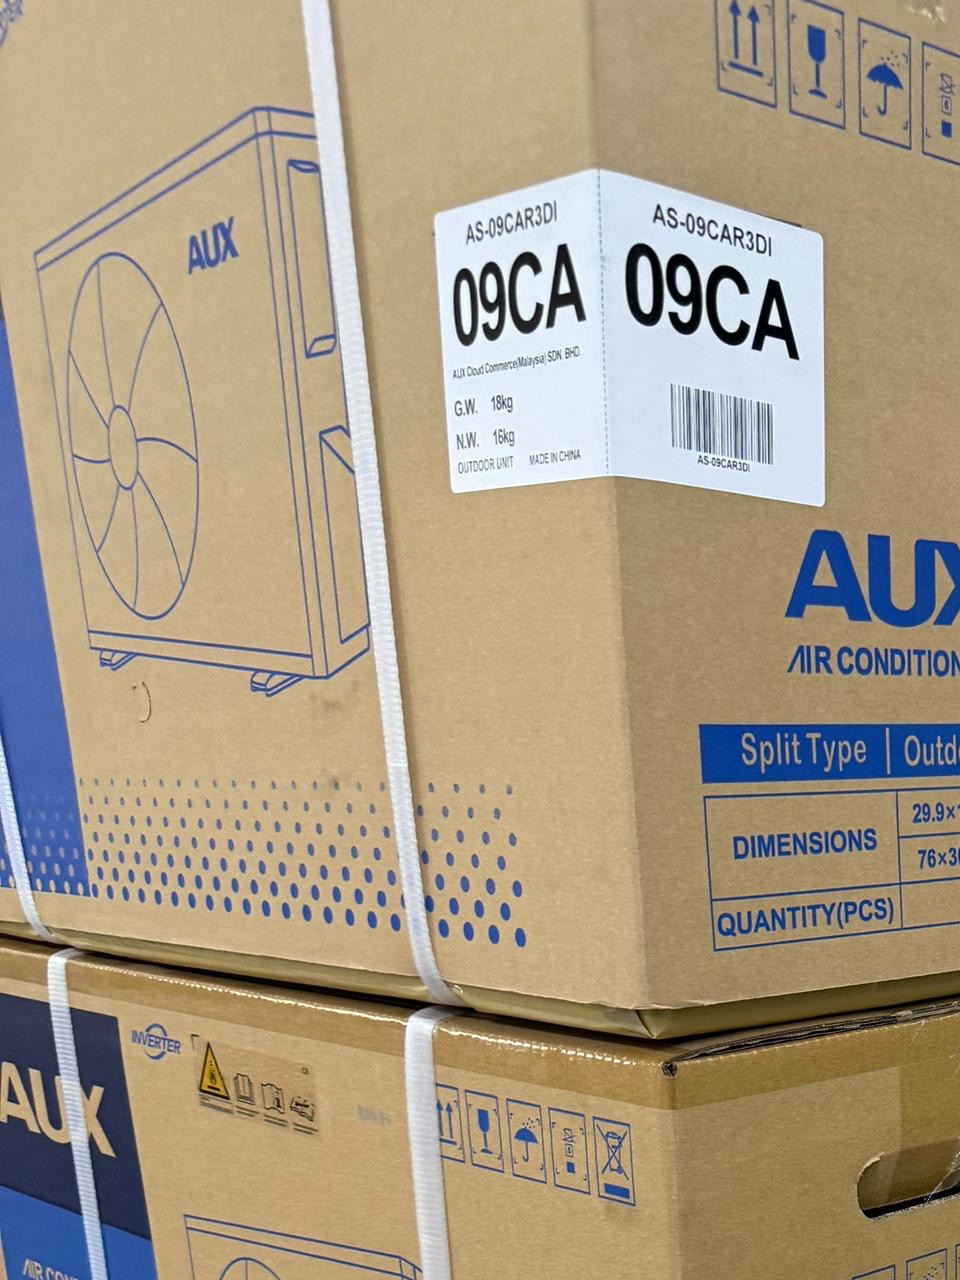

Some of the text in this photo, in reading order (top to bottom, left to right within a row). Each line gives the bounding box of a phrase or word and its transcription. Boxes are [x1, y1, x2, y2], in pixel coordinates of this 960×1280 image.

[466, 200, 557, 245] AS-09CAR3DI
[653, 203, 772, 257] AS-09CAR3DI
[187, 216, 240, 275] AUX
[453, 243, 587, 347] 09CA
[625, 243, 800, 360] 09CA
[467, 363, 484, 377] Cloud
[454, 394, 513, 417] G.W. 18kg
[456, 428, 515, 450] N.W. 16kg
[458, 455, 514, 474] OUTDOOR UNIT
[529, 449, 581, 466] MADE IN CHINA
[697, 454, 750, 473] AS-09CAR3DI
[786, 645, 833, 675] AIR
[740, 732, 802, 774] Split
[806, 732, 867, 772] Type
[732, 827, 878, 861] DIMENSIONS
[717, 896, 895, 938] QUANTITY(PCS)
[131, 1028, 181, 1056] INVERTER
[0, 1061, 117, 1158] AUX
